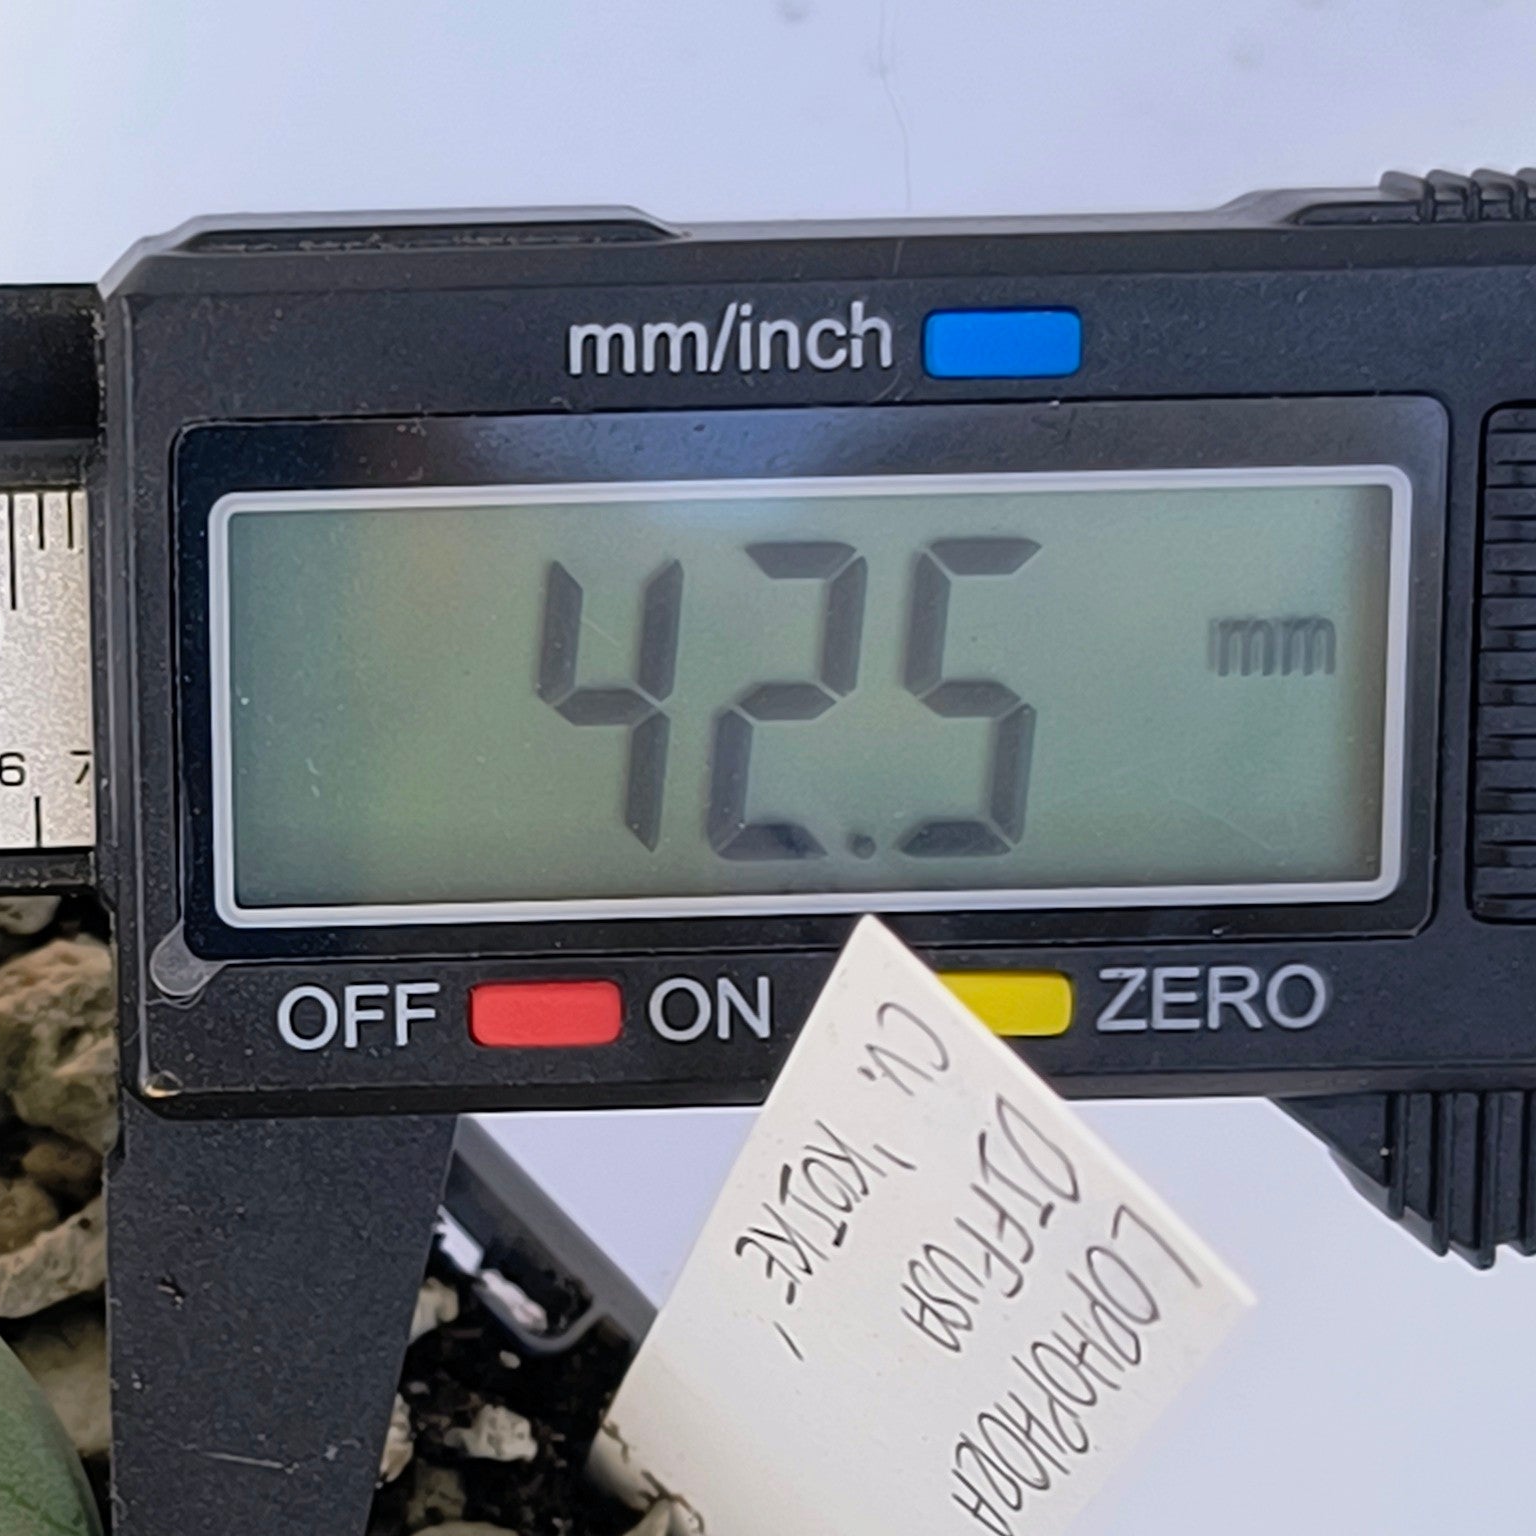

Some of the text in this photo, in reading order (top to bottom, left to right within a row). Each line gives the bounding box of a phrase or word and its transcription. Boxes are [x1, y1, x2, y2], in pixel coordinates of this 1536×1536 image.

[567, 301, 894, 378] mm/inch
[535, 537, 1338, 860] 42.5 mm
[274, 979, 442, 1053] OFF
[646, 973, 773, 1044] ON
[1094, 961, 1328, 1036] ZERO
[901, 1094, 1081, 1354] DIFFUSA
